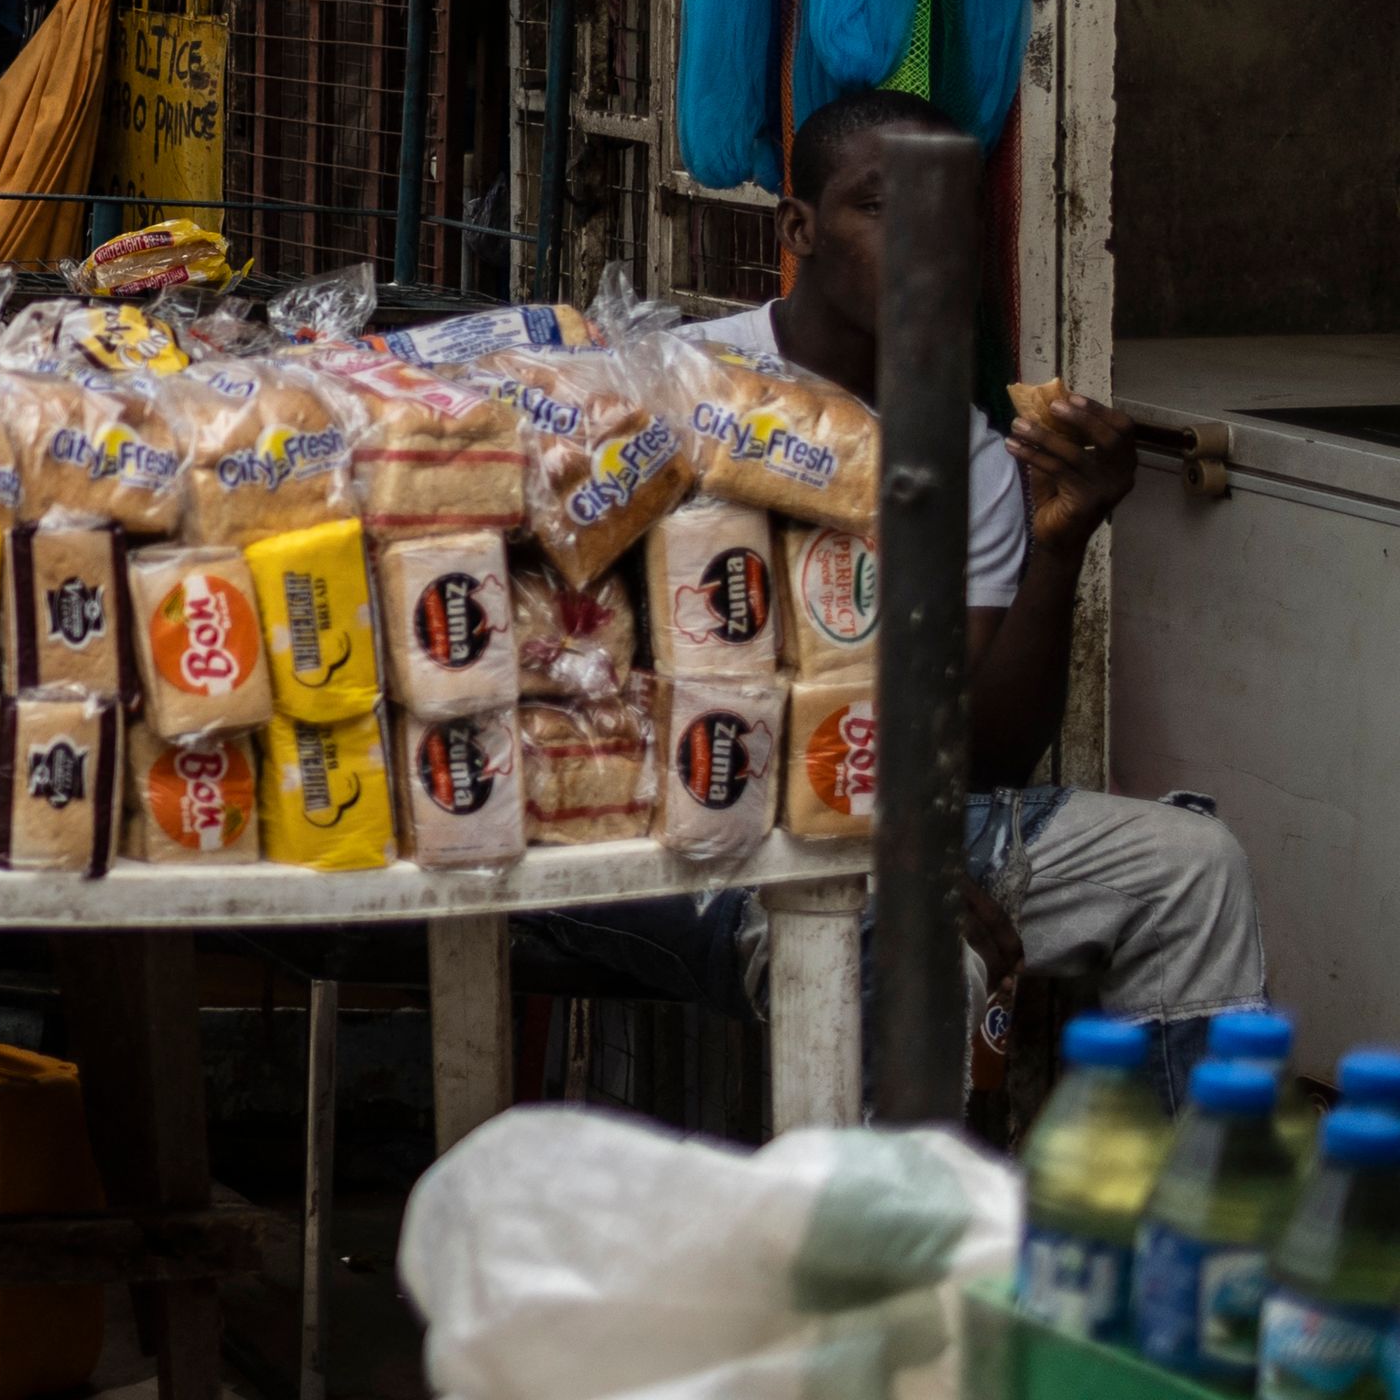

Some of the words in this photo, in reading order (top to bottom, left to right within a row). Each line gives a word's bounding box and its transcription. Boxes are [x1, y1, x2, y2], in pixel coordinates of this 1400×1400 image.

[52, 428, 106, 478] City
[120, 441, 178, 476] Fresh
[219, 453, 278, 491] City
[283, 428, 345, 465] Fresh
[693, 402, 752, 460] City
[766, 428, 835, 476] Fresh
[571, 471, 630, 522] City
[816, 549, 835, 590] Special
[832, 535, 857, 636] PERFECT
